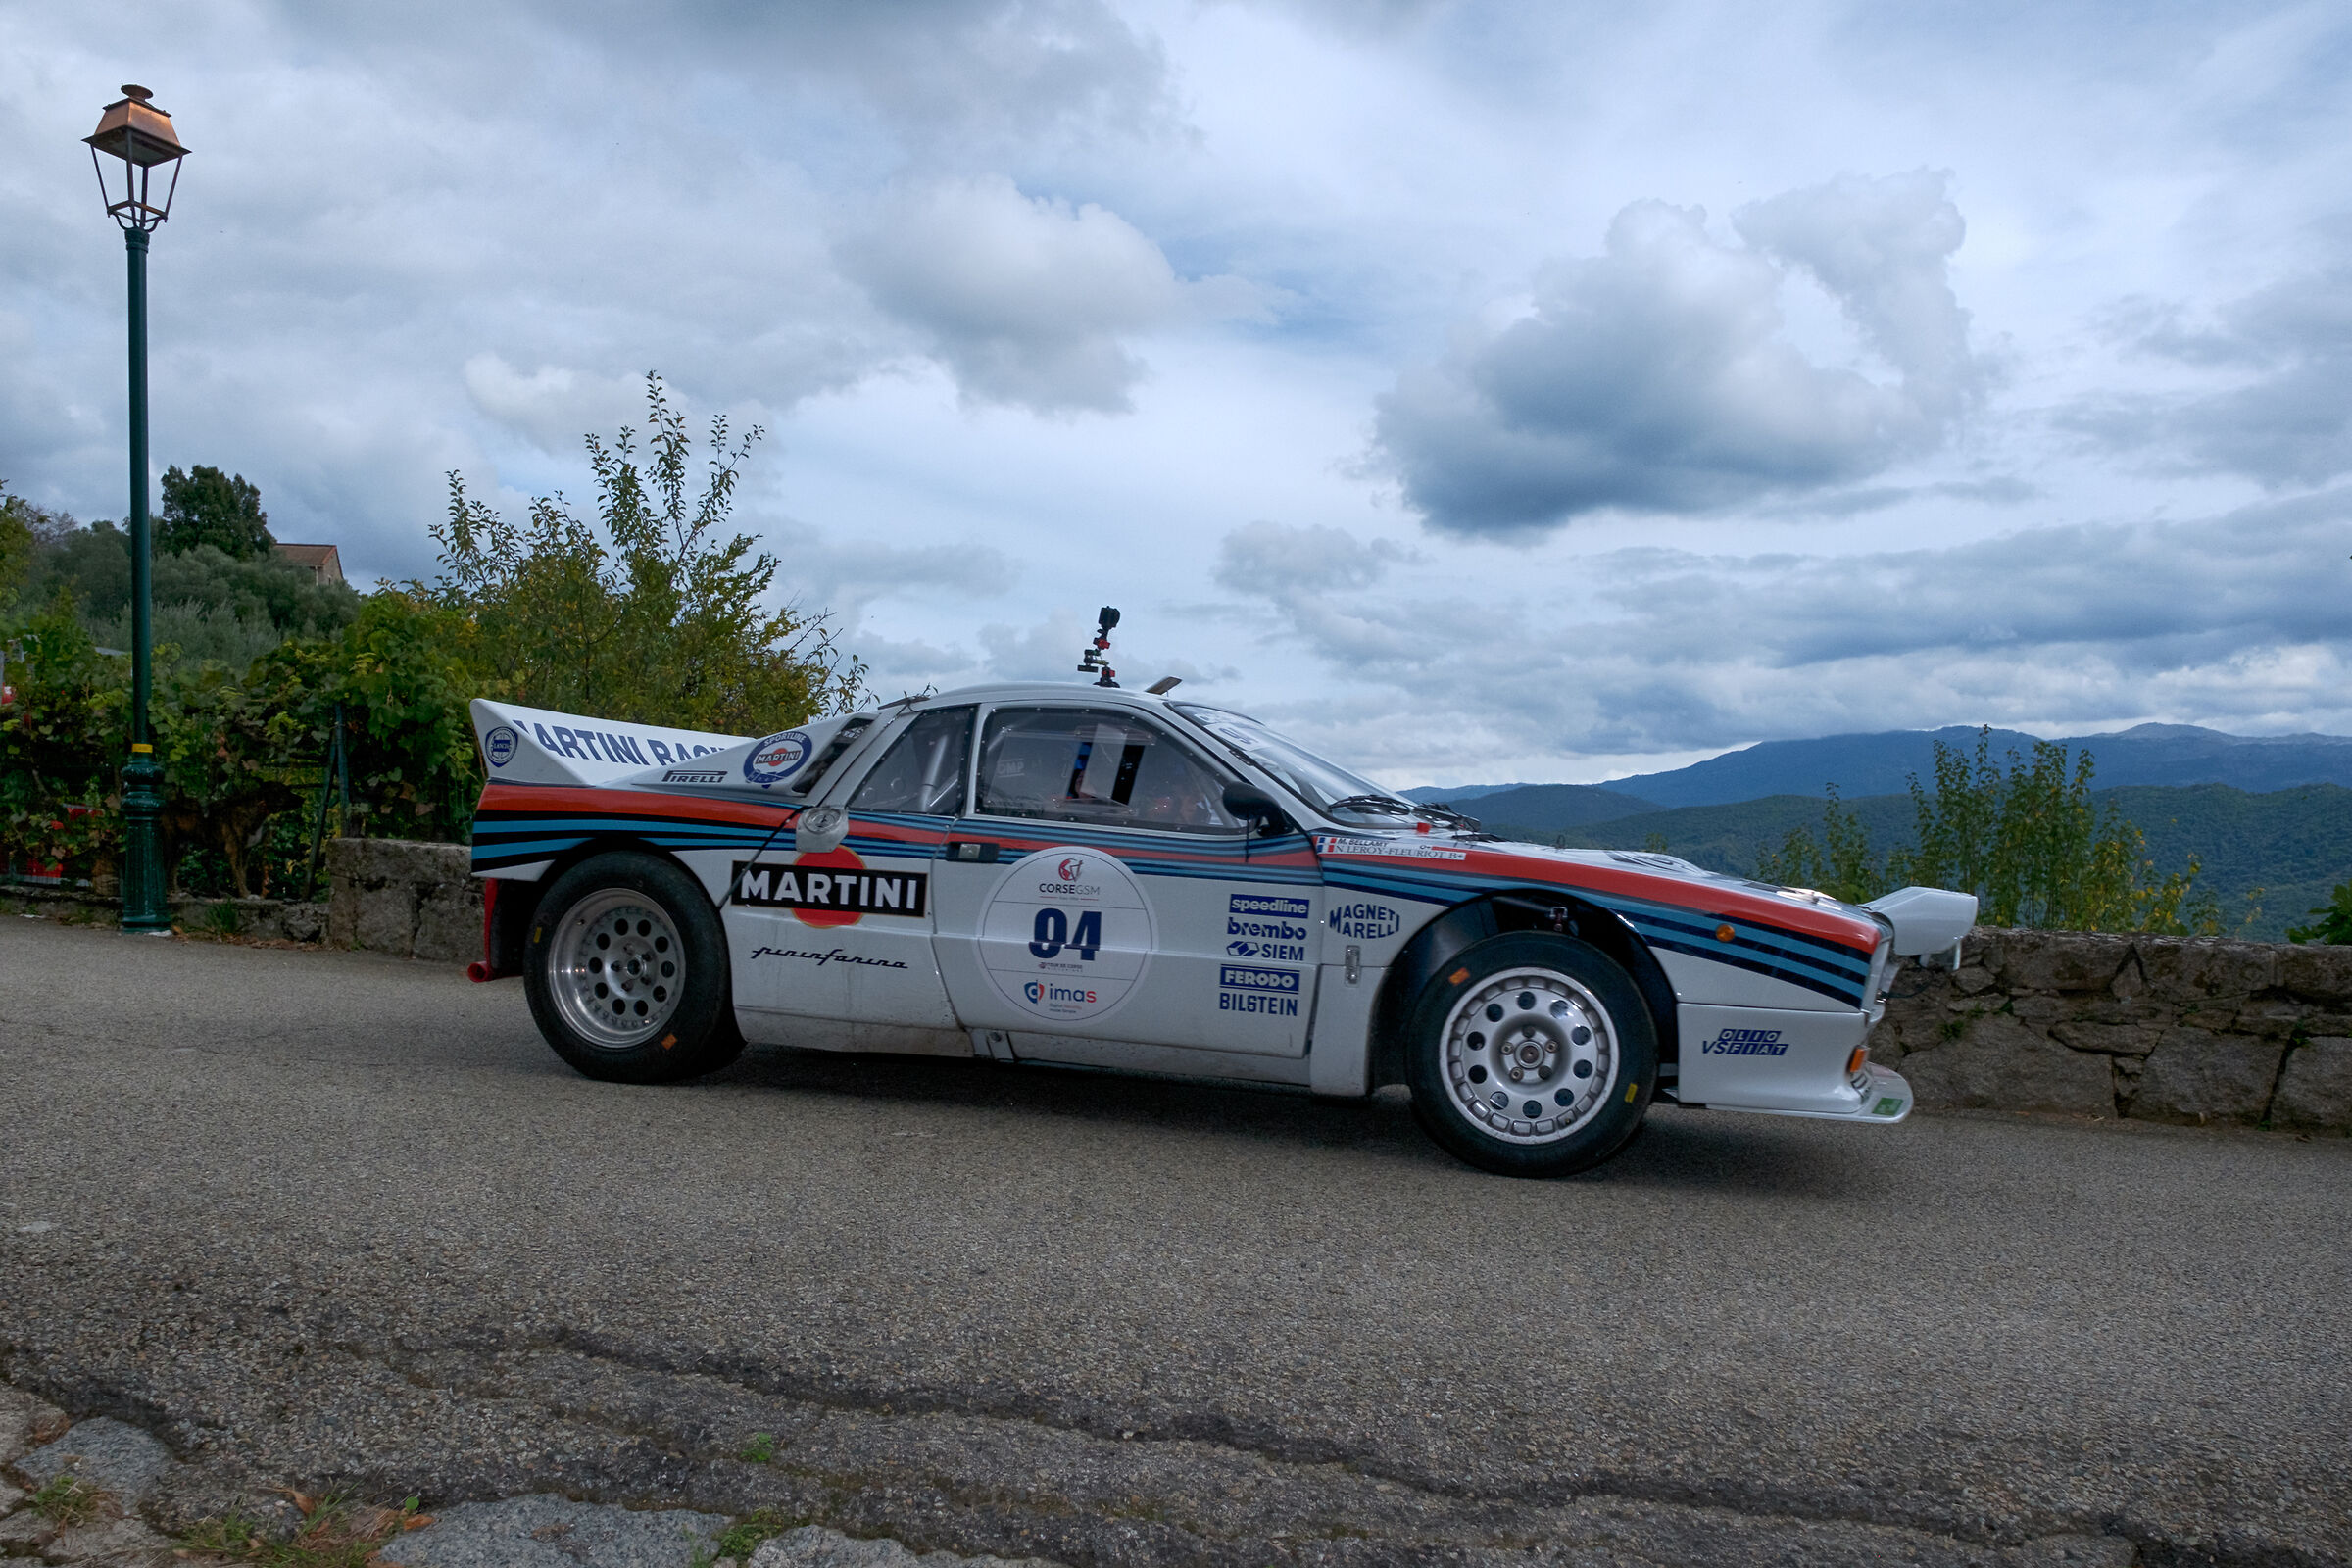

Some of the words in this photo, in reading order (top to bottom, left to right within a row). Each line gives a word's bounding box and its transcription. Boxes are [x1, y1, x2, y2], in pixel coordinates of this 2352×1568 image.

[513, 719, 650, 766] ARTINI
[757, 750, 801, 763] MARTINI
[662, 770, 728, 783] PIRELLI
[1347, 845, 1445, 858] LEROY-FLEURIOT
[1348, 838, 1388, 847] BELLAMY
[741, 870, 917, 909] MARTINI
[1230, 898, 1308, 914] speedline
[1028, 907, 1102, 961] 94
[1227, 917, 1307, 941] brembo
[750, 946, 908, 969] pininfarina
[1261, 943, 1304, 961] SIEM
[1225, 969, 1295, 989] FERODO
[1050, 983, 1097, 1003] imas
[1219, 992, 1298, 1016] BILSTEIN
[1721, 1030, 1779, 1042] OLIO
